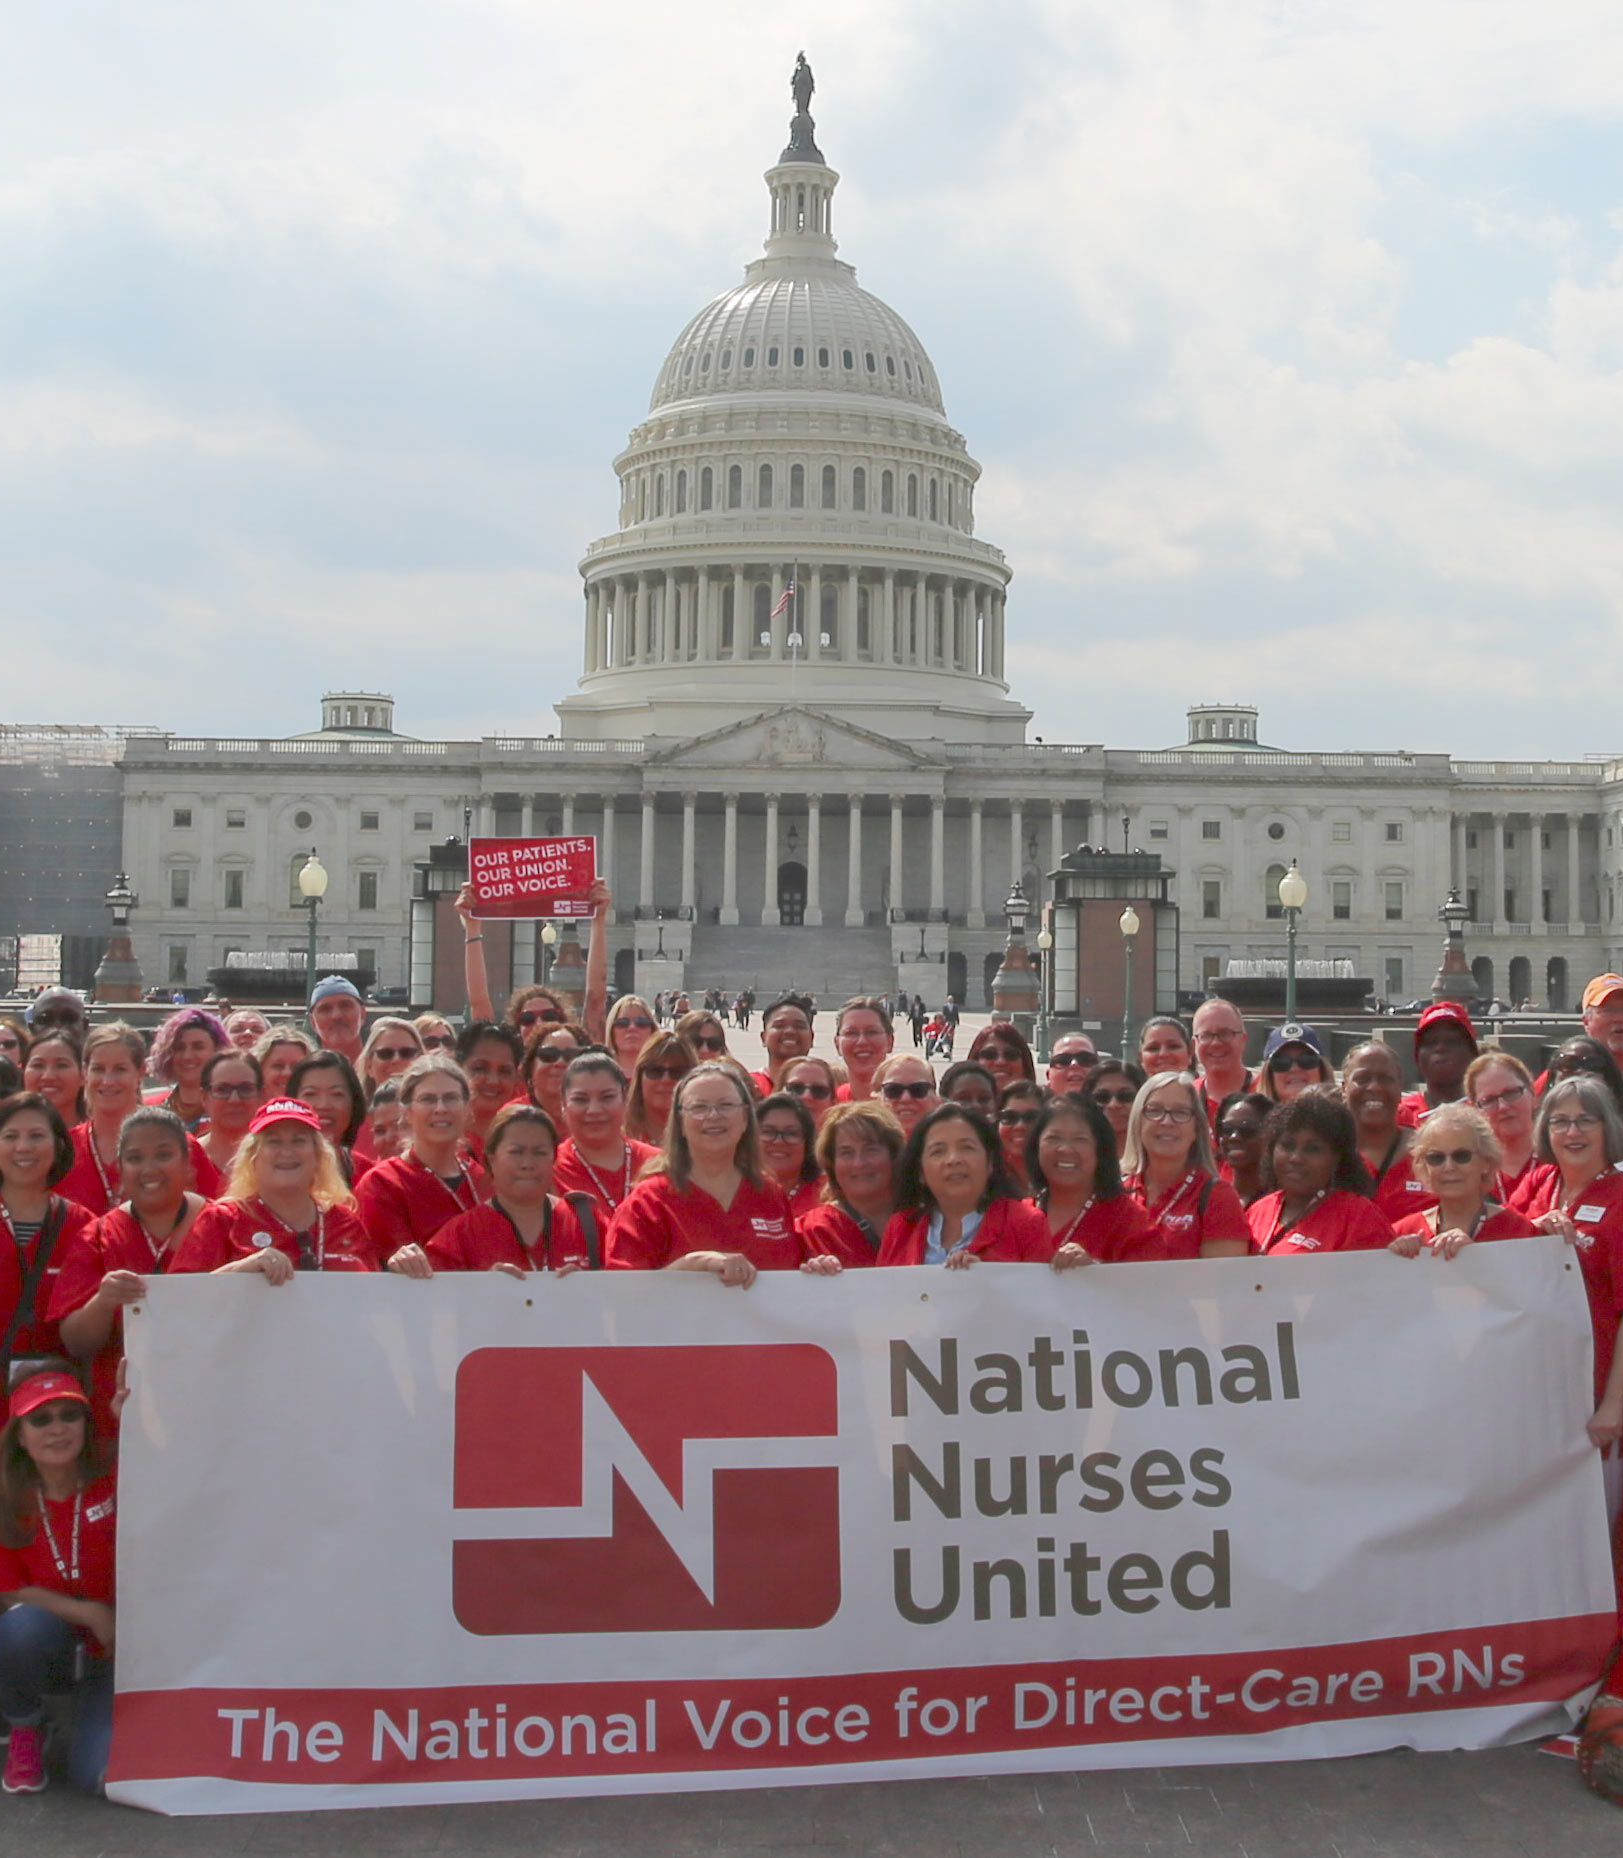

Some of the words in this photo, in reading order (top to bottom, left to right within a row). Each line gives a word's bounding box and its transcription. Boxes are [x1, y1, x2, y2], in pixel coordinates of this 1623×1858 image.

[474, 851, 509, 867] OUR
[512, 839, 591, 862] PATIENTS.
[477, 867, 512, 883] OUR
[515, 858, 572, 877] UNION.
[479, 883, 514, 899] OUR
[517, 875, 571, 893] VOICE.
[890, 1322, 1299, 1417] National
[893, 1442, 1231, 1523] Nurses
[894, 1529, 1231, 1625] United
[217, 1707, 343, 1763] The
[371, 1699, 656, 1761] National
[683, 1697, 870, 1750] Voice
[894, 1686, 988, 1737] for
[1013, 1668, 1384, 1730] Direct-Care
[1407, 1645, 1525, 1698] RNs
